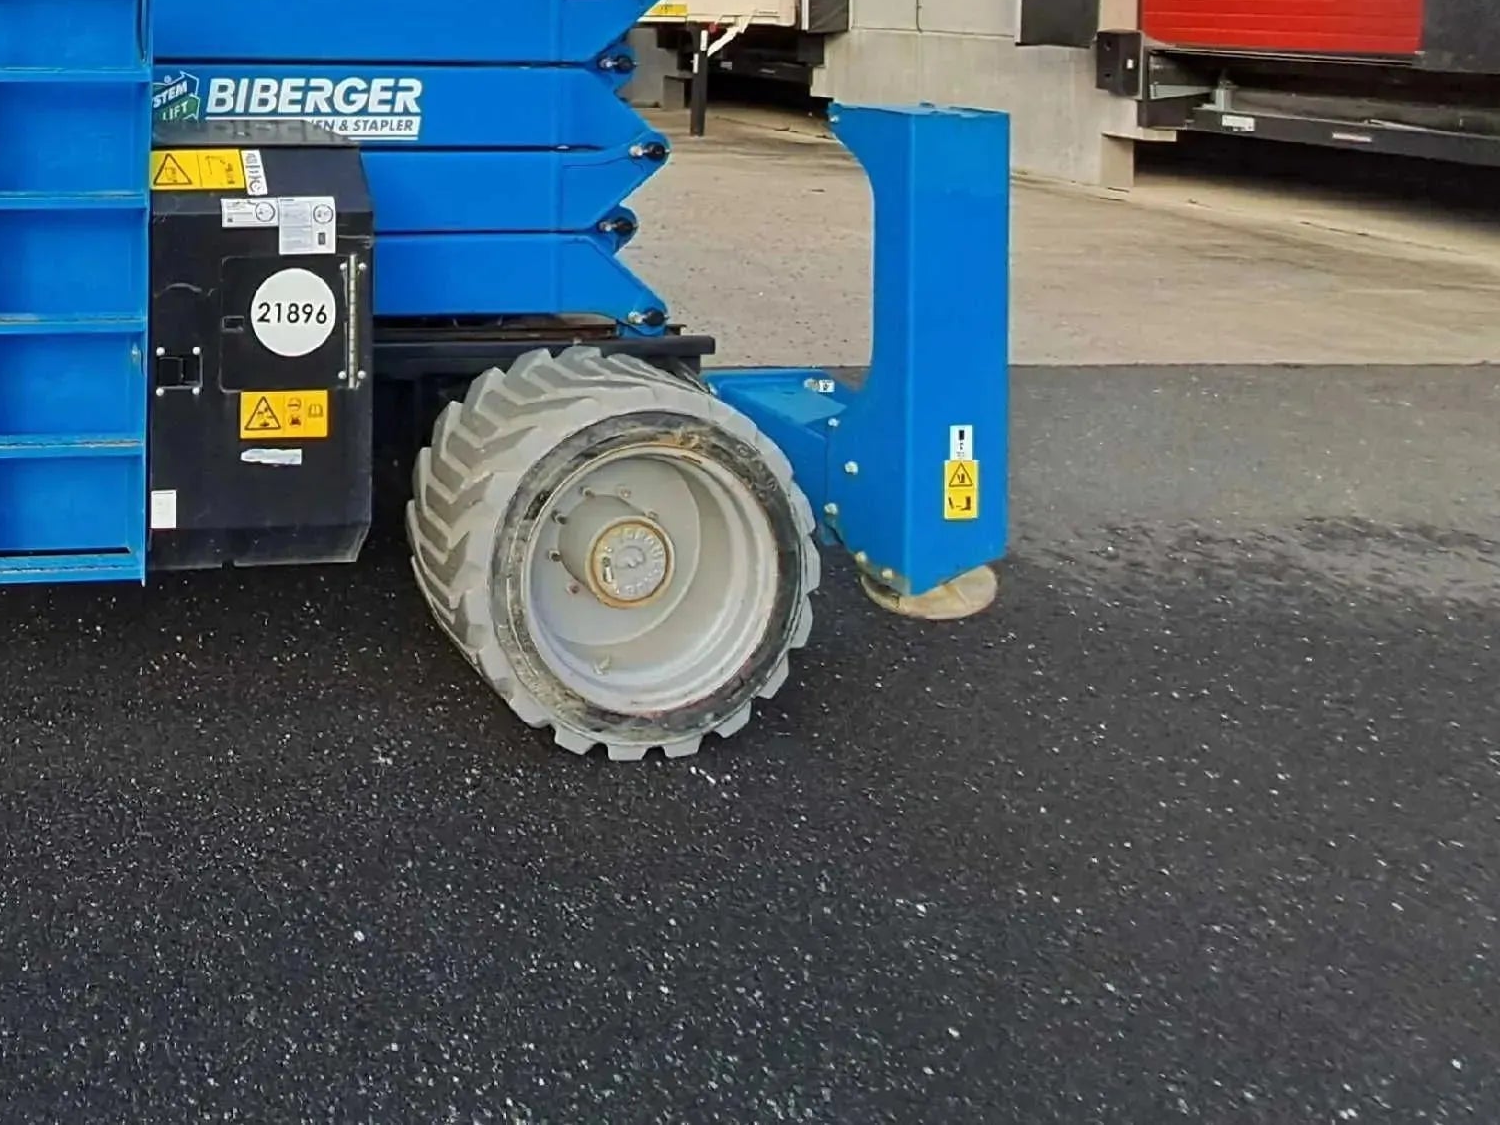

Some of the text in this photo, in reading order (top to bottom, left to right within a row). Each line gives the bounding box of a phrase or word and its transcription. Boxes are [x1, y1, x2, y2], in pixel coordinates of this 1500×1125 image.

[152, 80, 188, 109] STEM
[206, 77, 422, 114] BIBERGER
[352, 119, 414, 132] STAPLER
[256, 301, 328, 325] 21896
